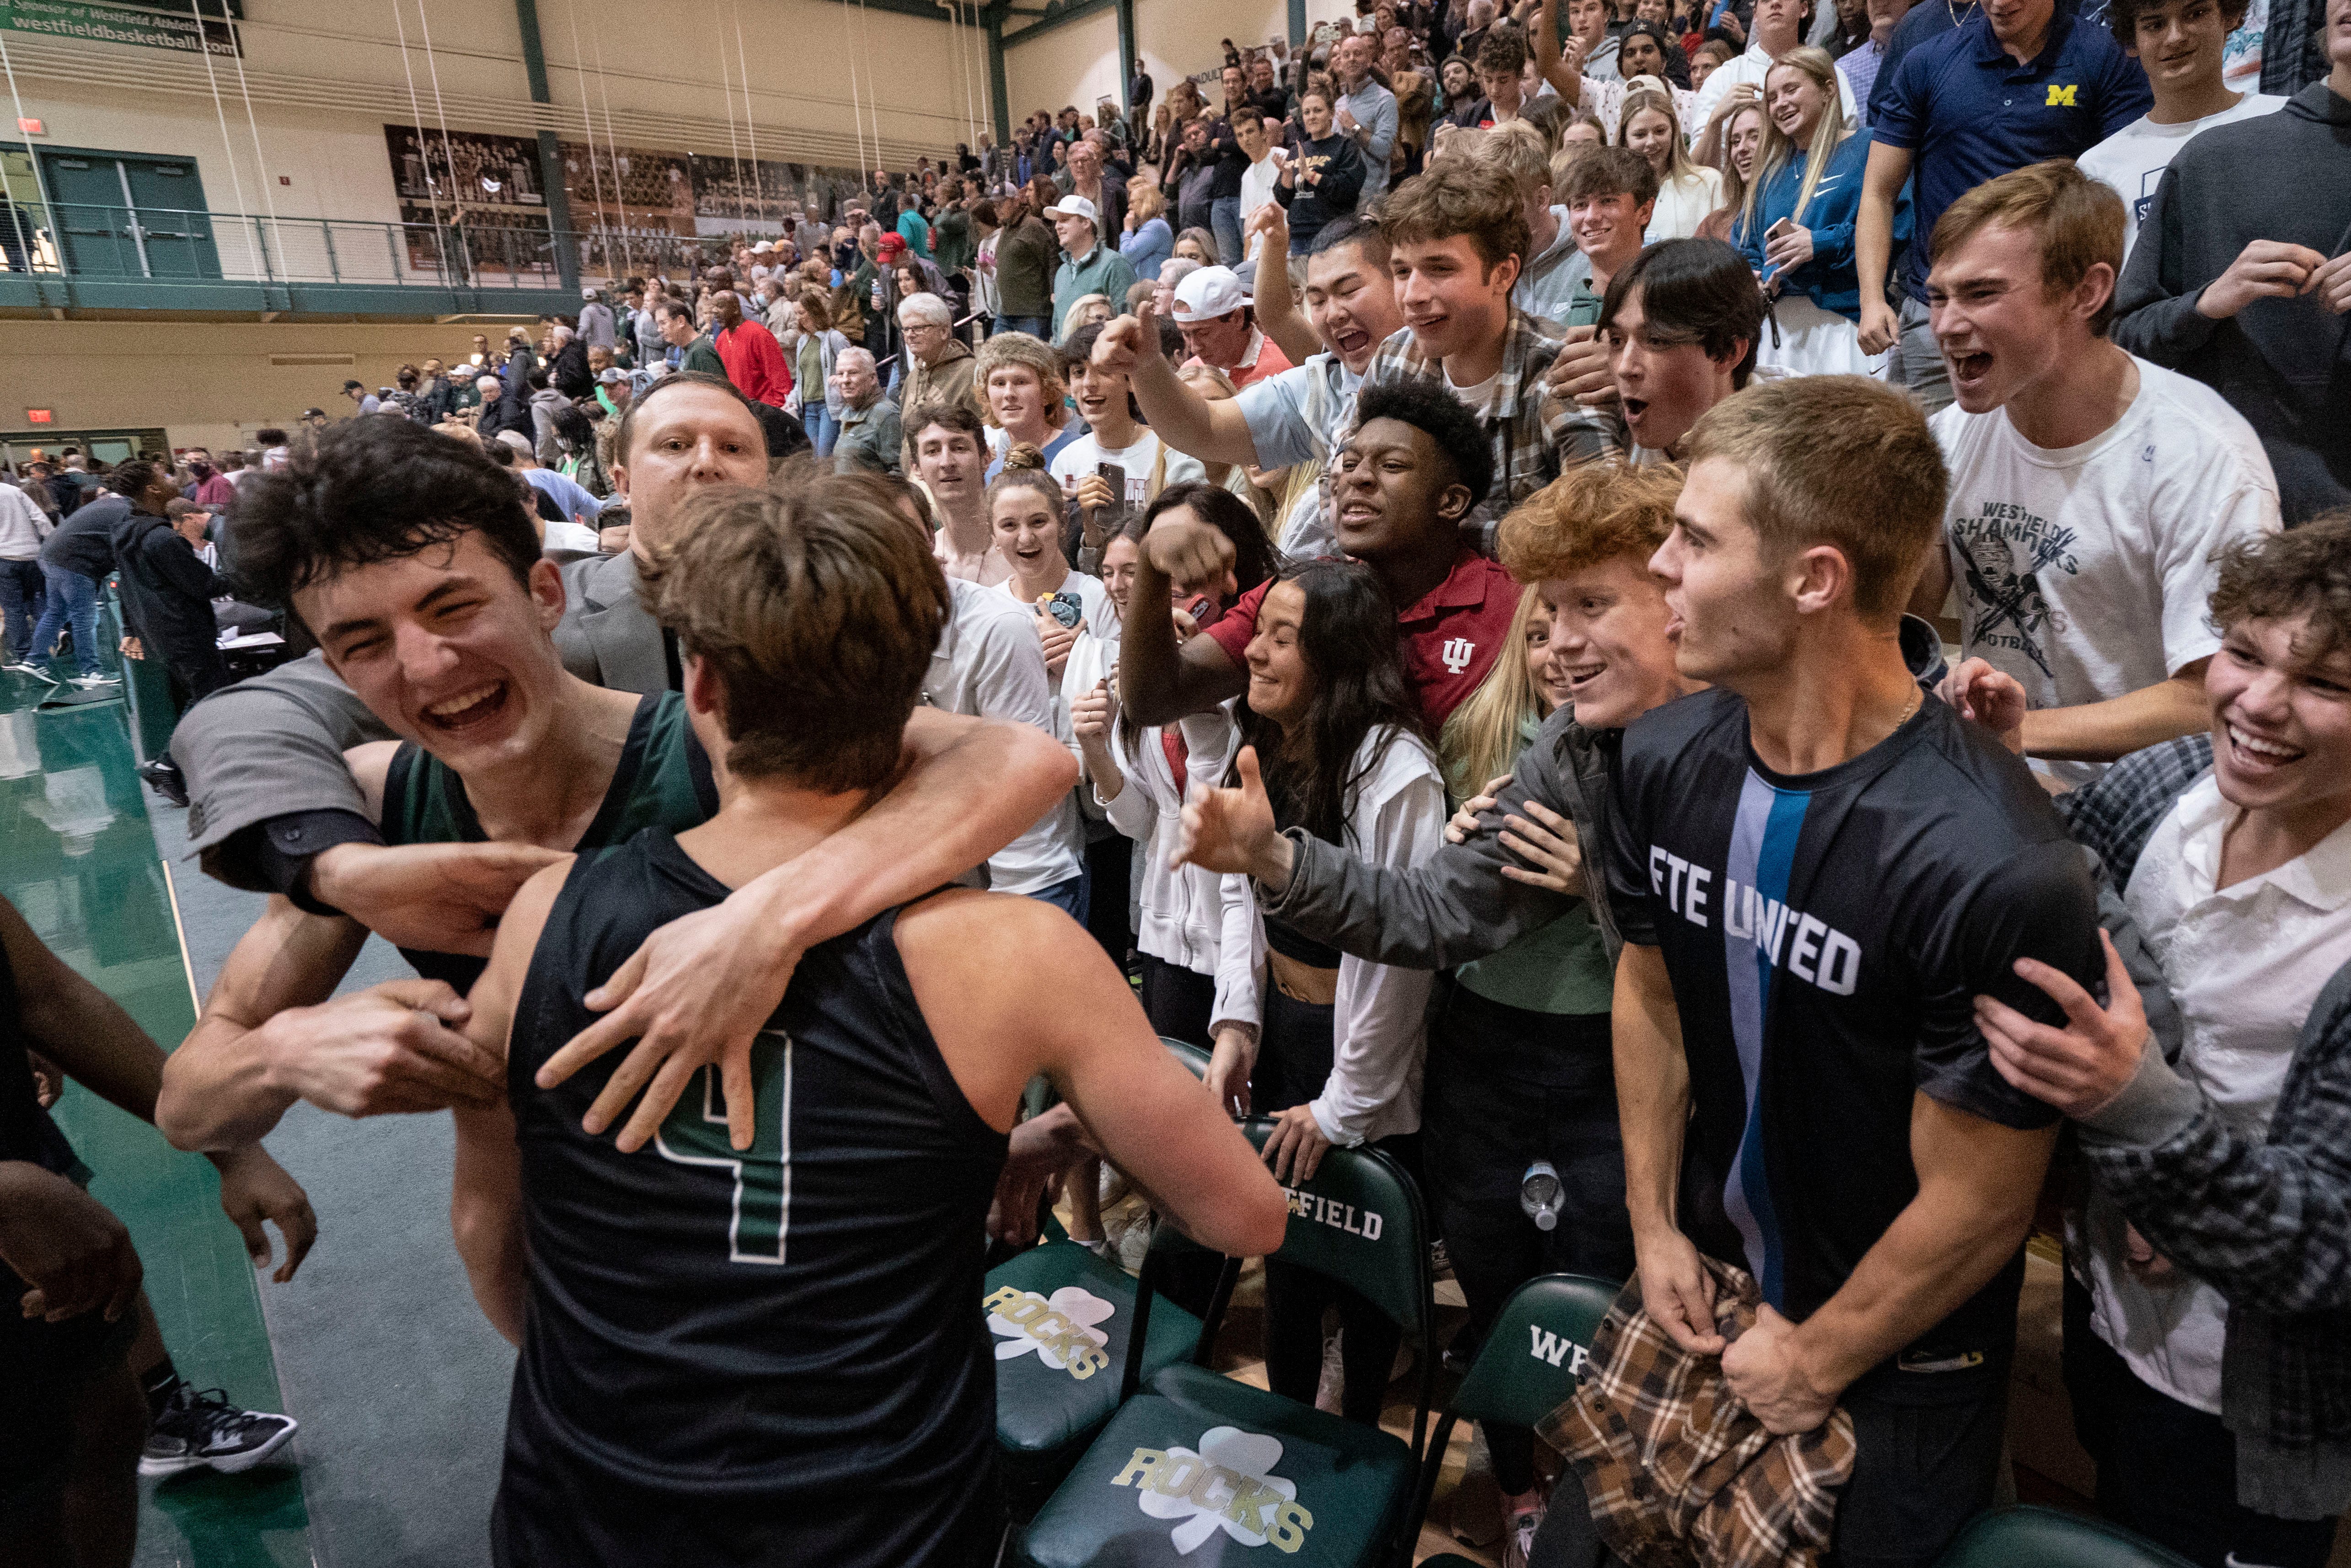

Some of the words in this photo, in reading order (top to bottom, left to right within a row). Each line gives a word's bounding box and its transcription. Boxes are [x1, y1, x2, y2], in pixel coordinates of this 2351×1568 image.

[2046, 85, 2078, 106] M
[1724, 878, 1862, 996] UNIED
[982, 1285, 1109, 1380] ROCKS
[1110, 1447, 1314, 1553] ROCKS
